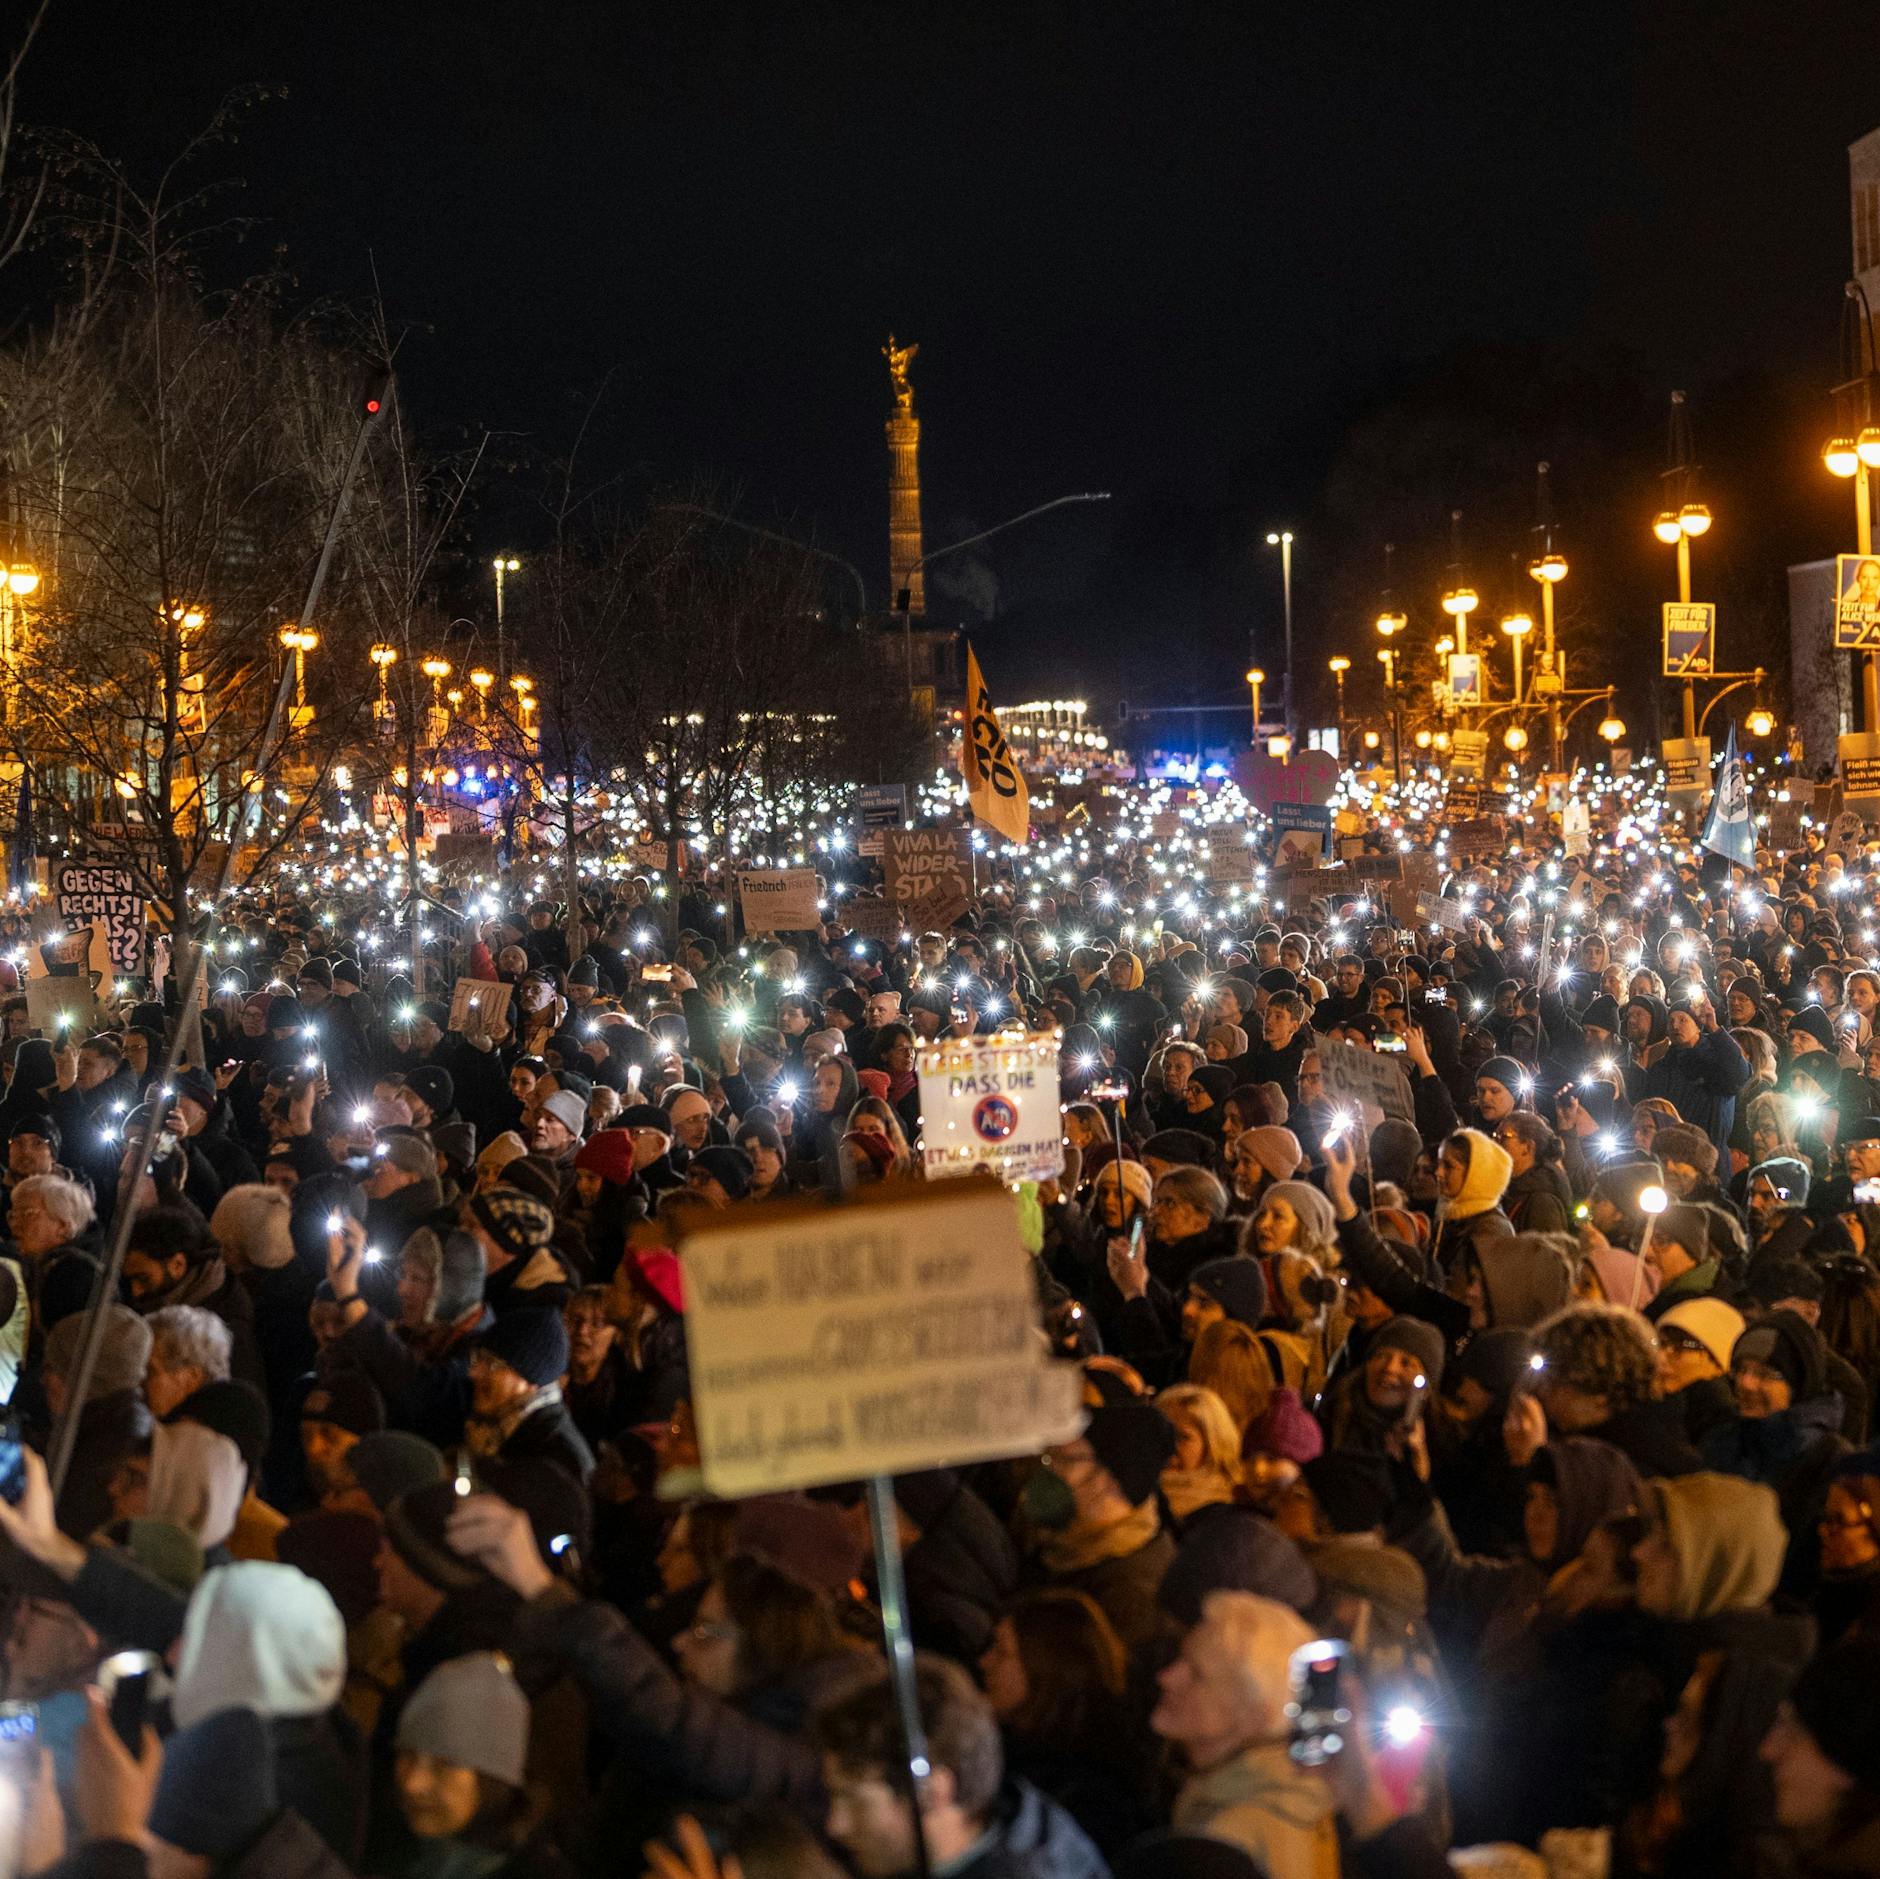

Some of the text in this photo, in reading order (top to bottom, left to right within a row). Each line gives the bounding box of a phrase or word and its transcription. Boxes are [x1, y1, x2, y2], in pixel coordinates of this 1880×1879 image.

[1669, 606, 1708, 620] ZEIT FÜR
[1846, 760, 1868, 769] Fleiß
[1847, 770, 1867, 779] sich
[1277, 817, 1327, 829] uns lieber
[893, 833, 932, 851] VIVA
[935, 833, 958, 850] LA
[893, 853, 969, 874] WIDER-
[61, 868, 134, 893] GEGEN
[741, 876, 787, 893] Friedrich
[60, 896, 141, 926] RECHTS!
[950, 1071, 1036, 1096] DASS DIE
